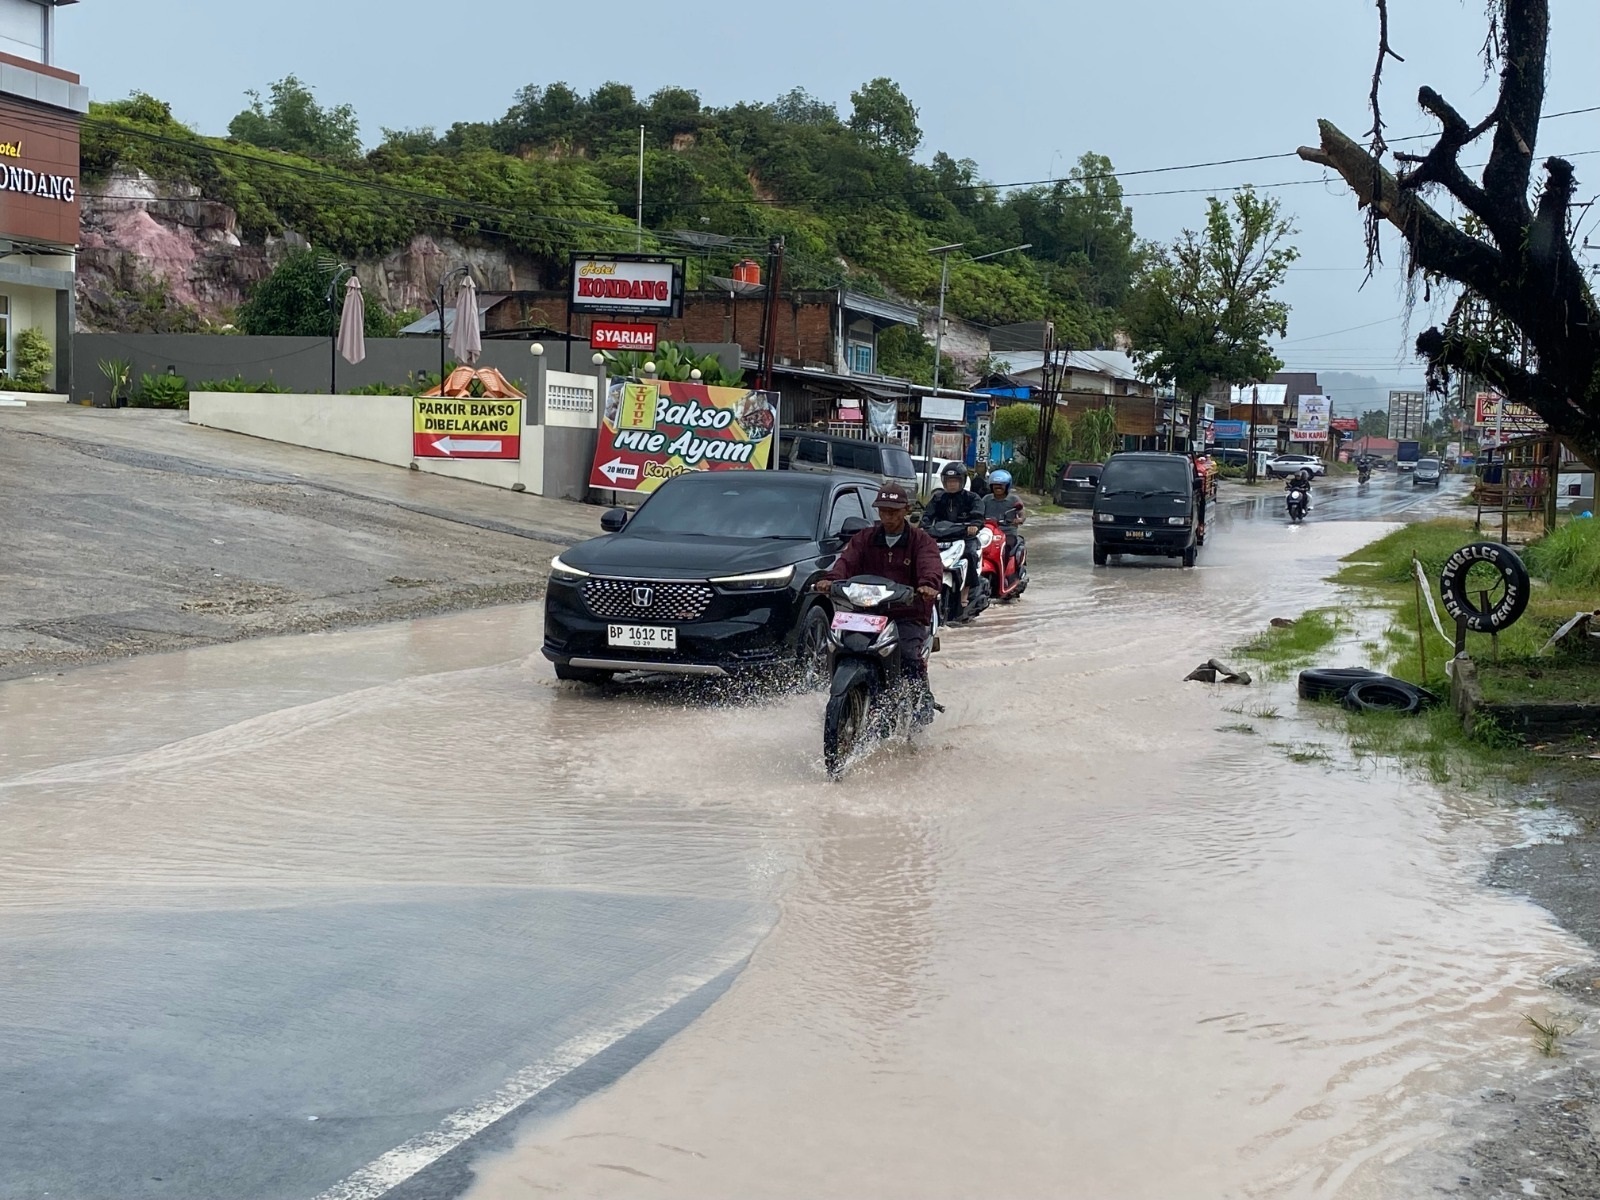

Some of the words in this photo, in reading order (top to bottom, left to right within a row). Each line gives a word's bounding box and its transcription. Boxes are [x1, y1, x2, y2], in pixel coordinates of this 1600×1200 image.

[0, 163, 75, 202] ONDANG
[580, 262, 617, 276] Hotel
[578, 277, 668, 300] KONDANG
[596, 329, 653, 344] SYARIAH
[419, 403, 466, 416] PARKIR
[470, 404, 514, 416] BAKSO
[632, 386, 647, 426] TUTUP
[656, 397, 731, 429] Bakso
[425, 418, 508, 432] DIBELAKANG
[1294, 431, 1308, 439] NASI
[615, 431, 666, 450] Mie
[668, 431, 753, 464] Ayam
[606, 465, 615, 473] 20
[616, 466, 635, 475] METER
[644, 460, 702, 478] Kond
[1442, 546, 1499, 578] TUBELES
[1442, 589, 1482, 630] TEMEL
[610, 626, 623, 639] BP
[629, 627, 655, 641] 1612
[661, 629, 674, 641] CE
